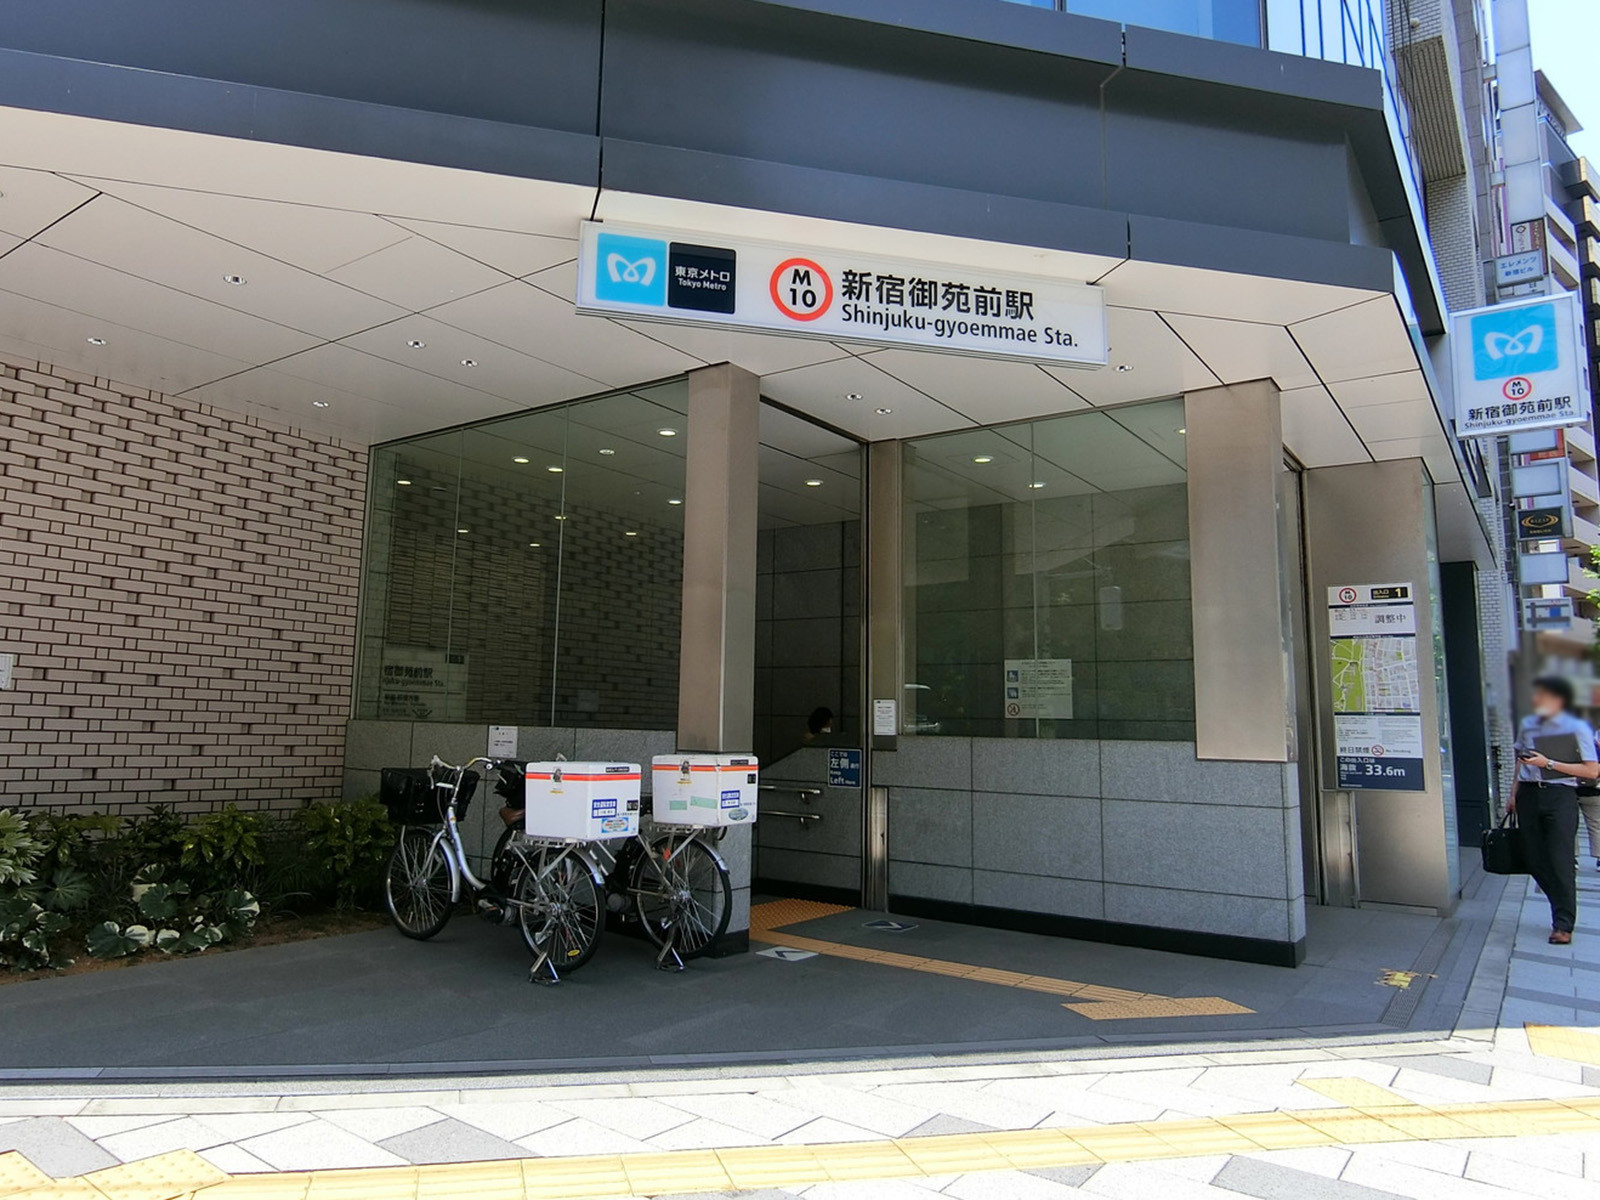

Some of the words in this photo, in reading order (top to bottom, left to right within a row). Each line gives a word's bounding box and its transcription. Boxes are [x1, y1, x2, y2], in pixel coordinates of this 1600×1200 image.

[675, 265, 730, 282] 東京メトロ
[792, 268, 812, 287] M
[678, 277, 702, 289] Tokyo
[703, 280, 727, 291] Metro
[789, 287, 817, 308] 10
[841, 269, 1035, 321] 新宿御苑前駅
[842, 304, 1037, 343] Shinjuku-gyoemmae
[1044, 327, 1079, 348] Sta.
[1511, 387, 1525, 396] 10
[1468, 396, 1572, 421] 新宿御苑前駅
[1464, 413, 1557, 430] Shinjuku-gyoemmae
[1395, 588, 1402, 598] 1
[1365, 764, 1406, 777] 33.6m
[830, 776, 845, 784] Left
